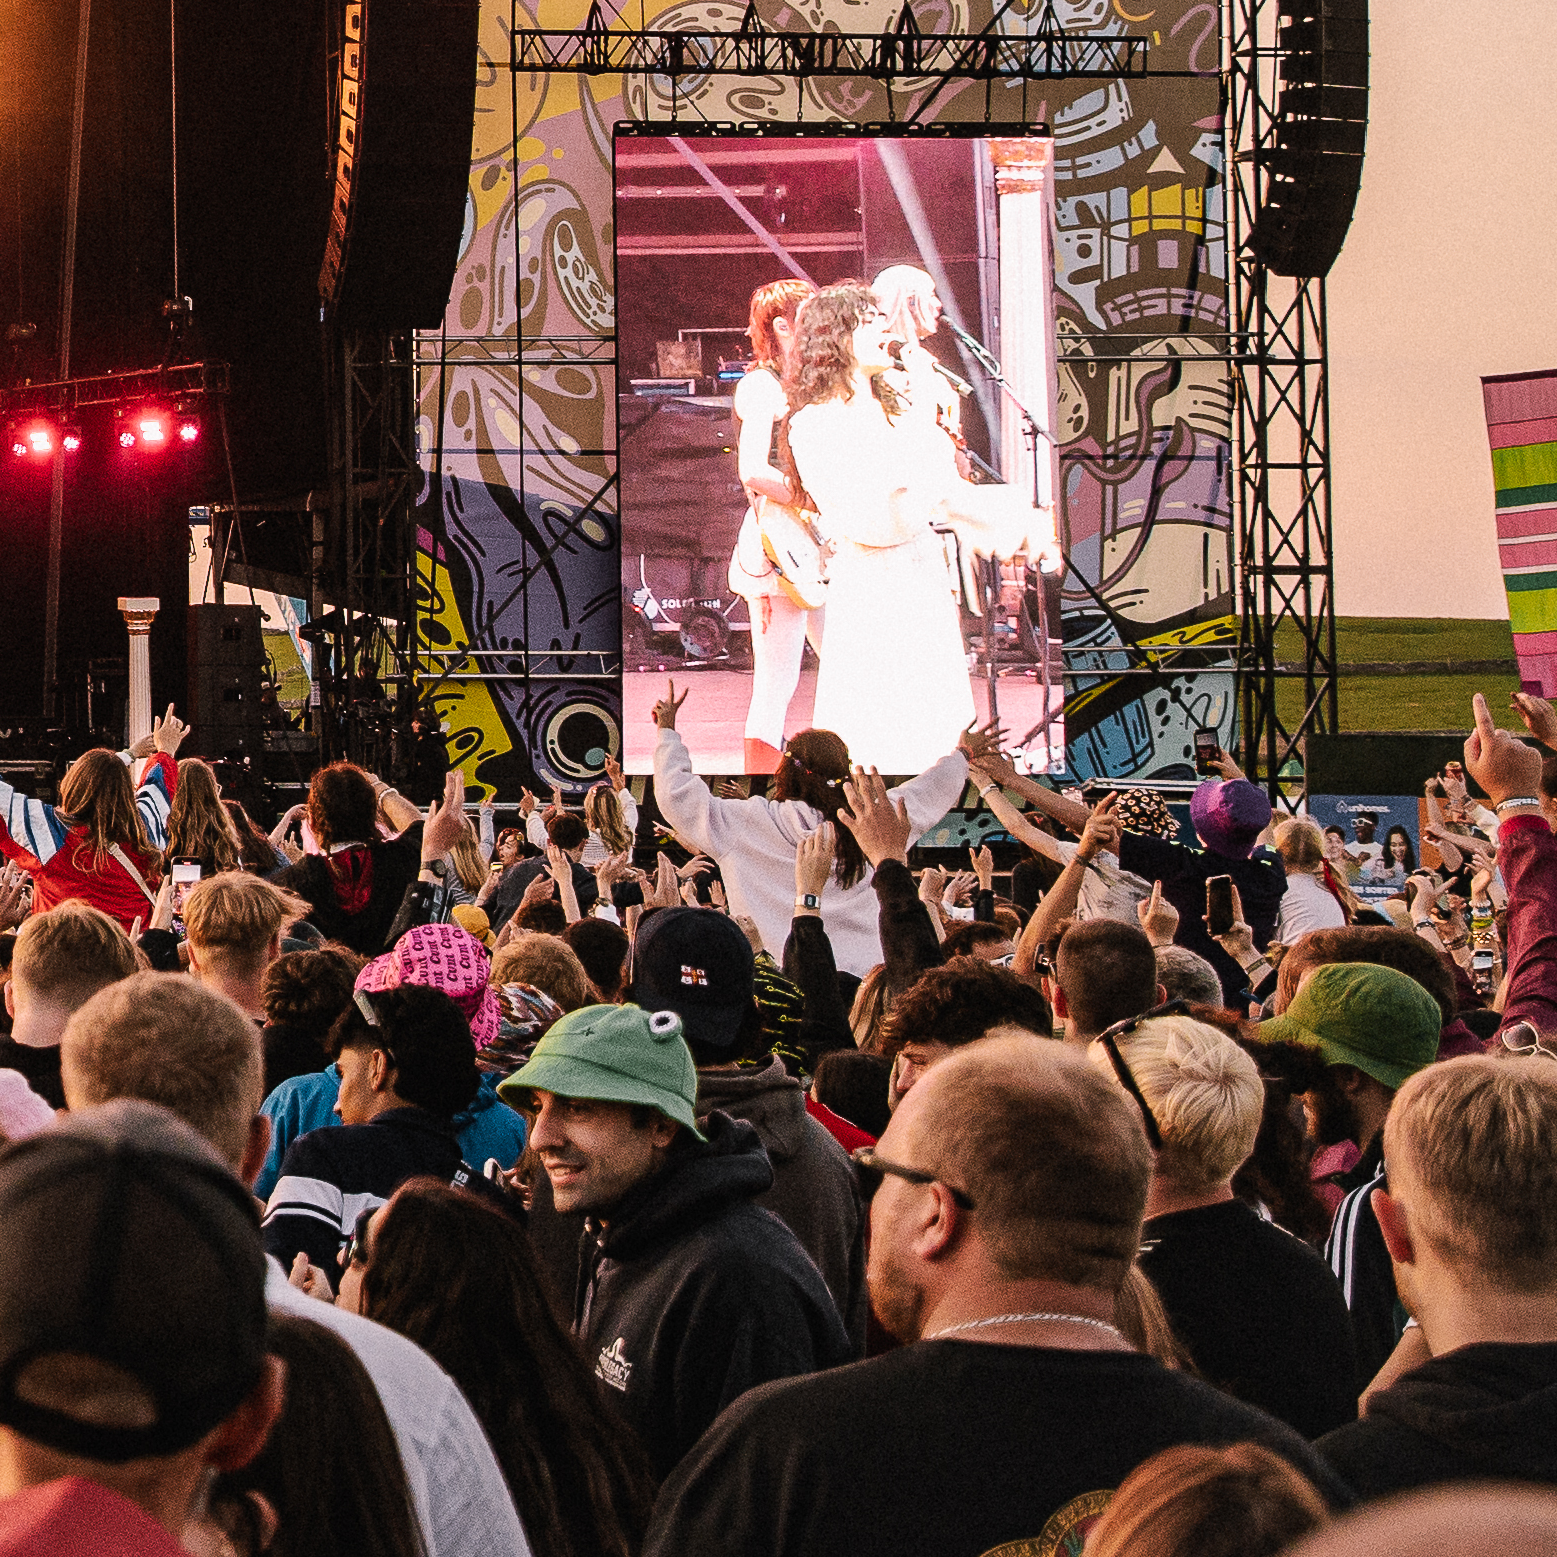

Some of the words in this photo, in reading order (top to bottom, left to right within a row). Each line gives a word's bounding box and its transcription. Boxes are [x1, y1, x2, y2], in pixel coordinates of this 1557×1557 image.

[427, 940, 442, 965] Cunt
[458, 943, 472, 970] Cunt
[445, 953, 459, 983] Cunt
